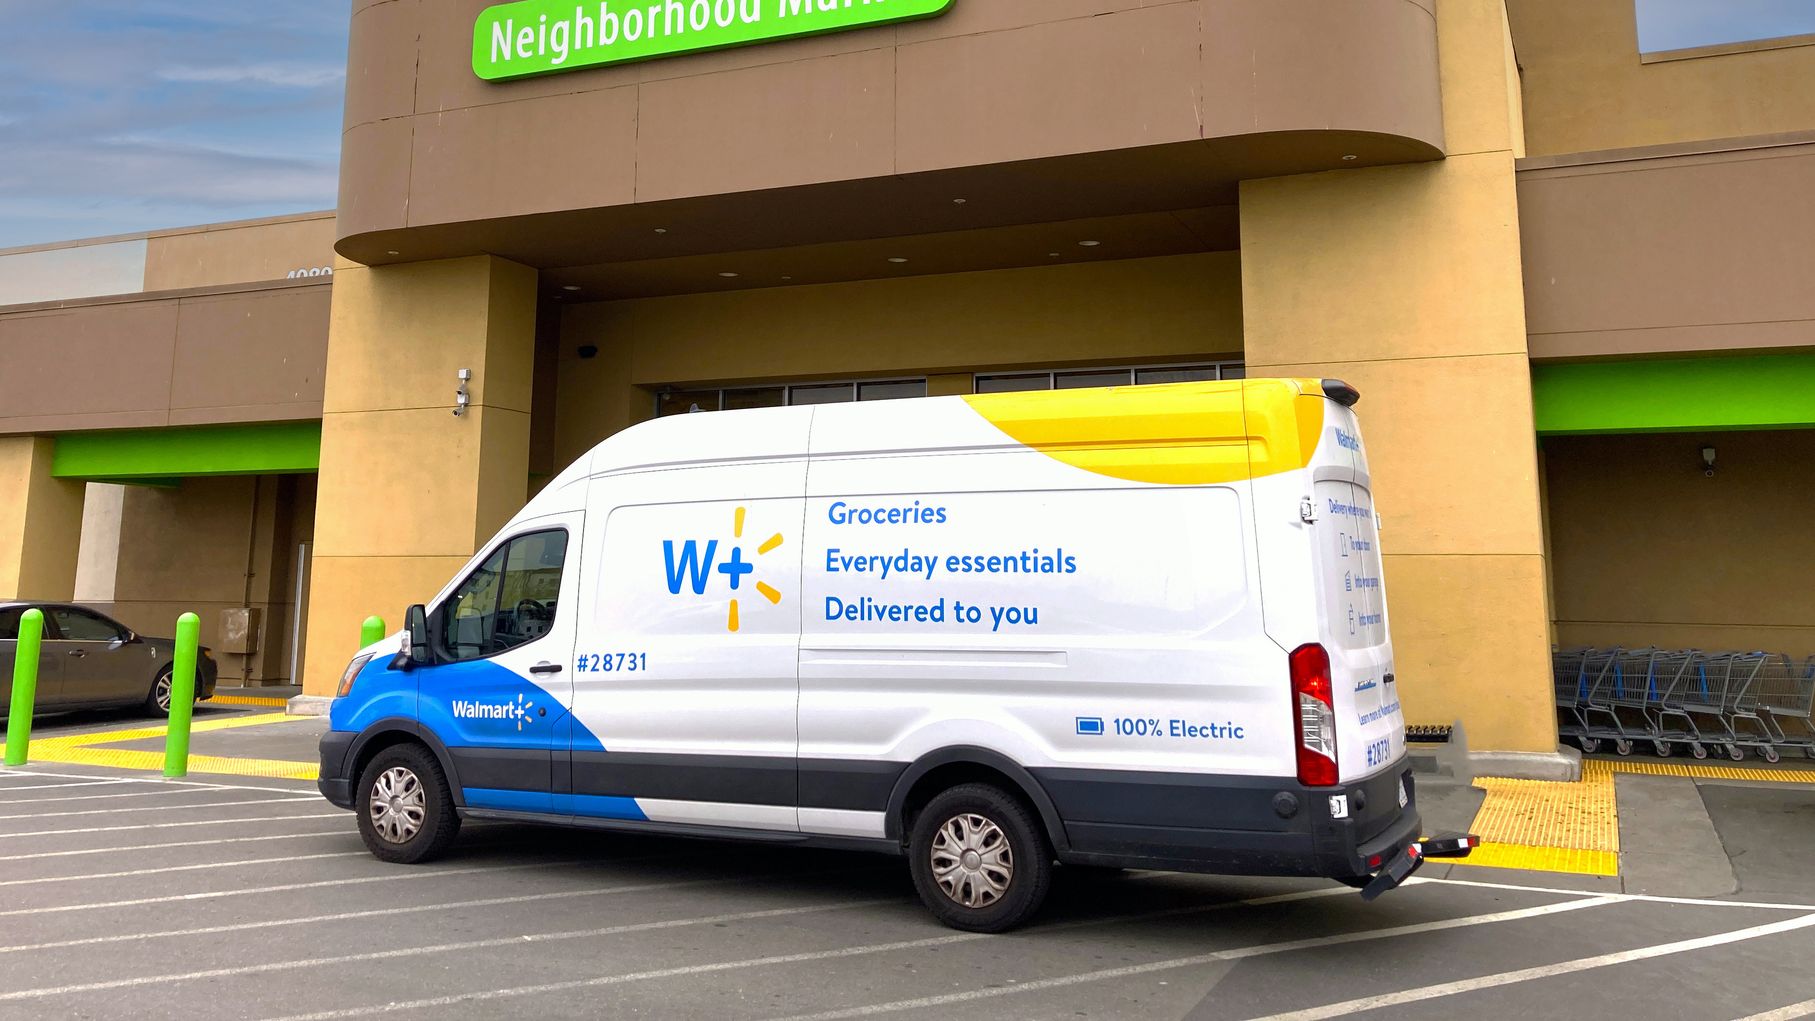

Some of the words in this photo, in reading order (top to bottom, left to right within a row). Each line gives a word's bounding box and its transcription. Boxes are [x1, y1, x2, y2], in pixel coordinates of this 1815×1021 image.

[828, 500, 947, 525] Groceries
[826, 548, 939, 580] Everyday
[945, 547, 1077, 574] essentials
[825, 596, 945, 624] Delivered
[953, 600, 982, 624] to
[989, 606, 1039, 632] you
[576, 652, 646, 673] #28731
[1113, 717, 1163, 737] 100%
[1169, 719, 1245, 739] Electric
[1367, 738, 1391, 767] #28731
